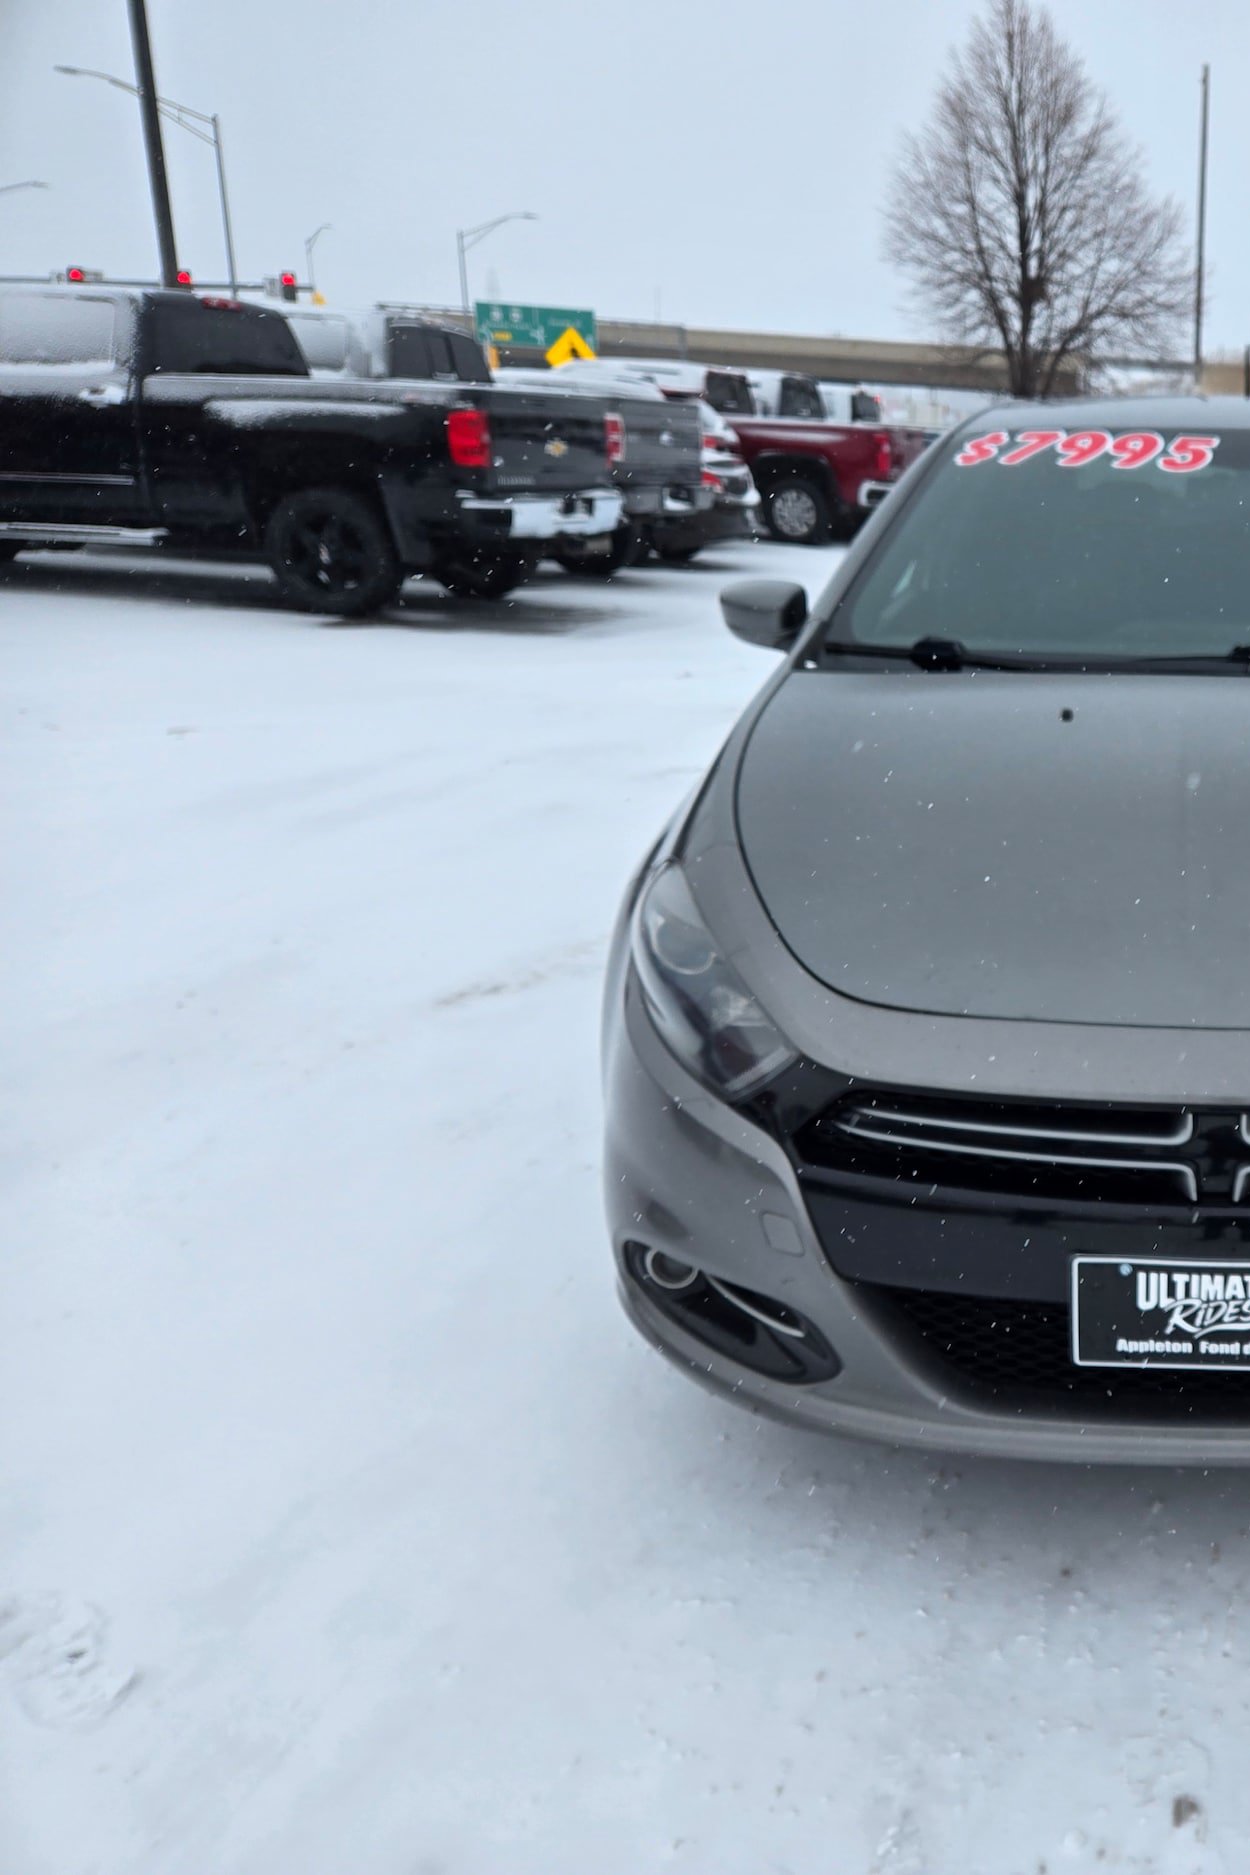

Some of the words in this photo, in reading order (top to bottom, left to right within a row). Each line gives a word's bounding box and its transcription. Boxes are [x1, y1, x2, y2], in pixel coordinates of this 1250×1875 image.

[954, 430, 1220, 473] $7995
[1116, 1338, 1193, 1354] Appleton
[1199, 1341, 1240, 1355] Fond
